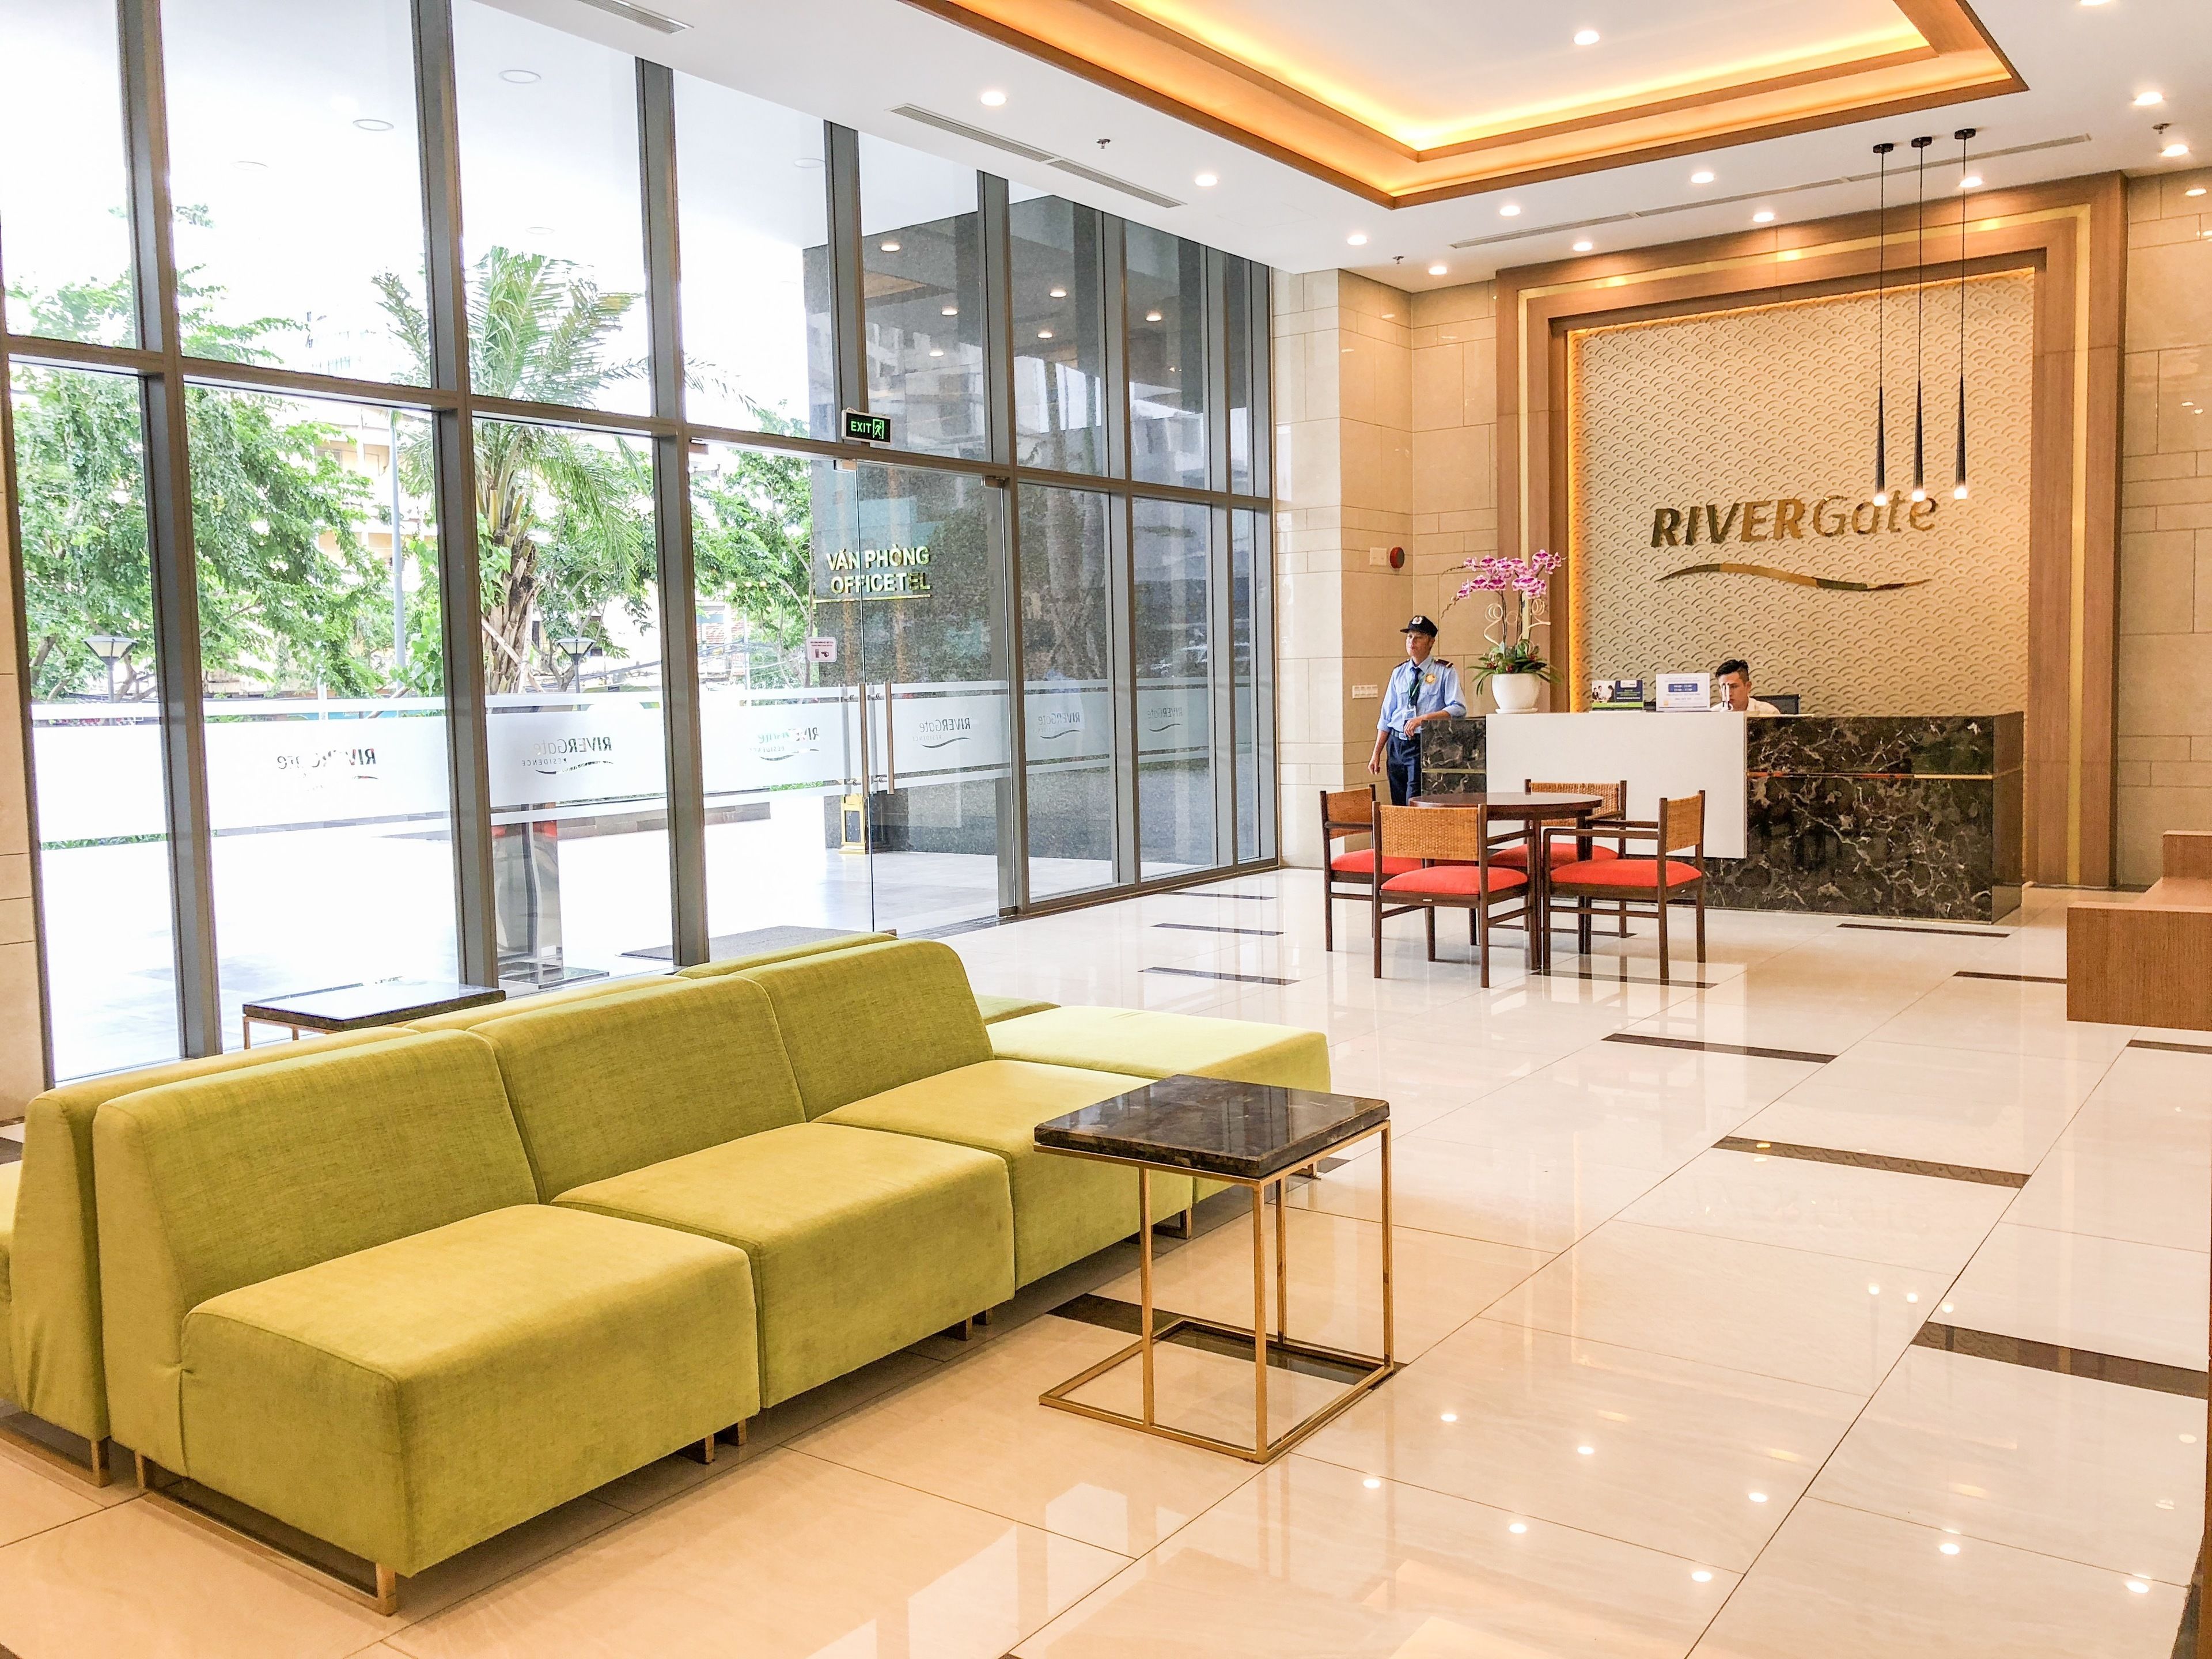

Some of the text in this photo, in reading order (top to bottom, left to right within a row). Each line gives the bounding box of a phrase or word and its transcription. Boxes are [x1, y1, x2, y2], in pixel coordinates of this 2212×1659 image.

[851, 421, 872, 433] EXIT
[1651, 490, 1937, 547] RIVERGate
[865, 543, 930, 569] PHÒNG
[831, 572, 931, 594] OFFICETEL
